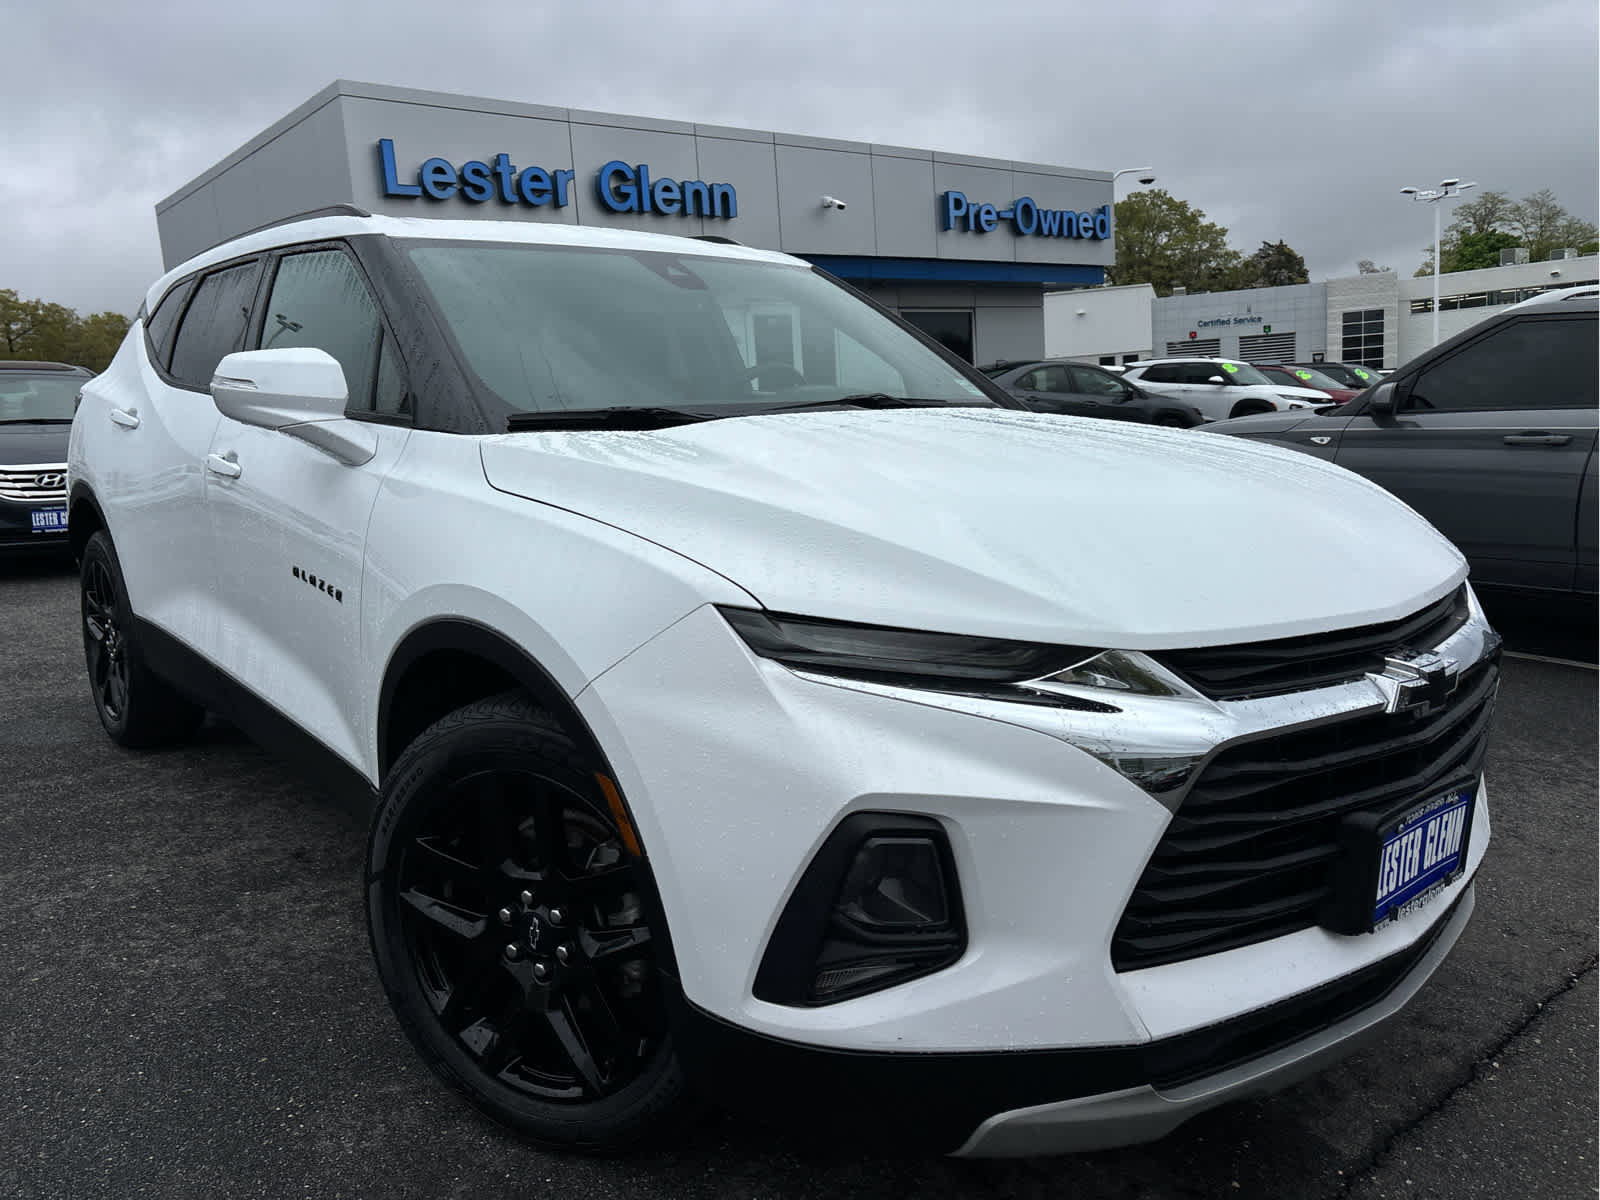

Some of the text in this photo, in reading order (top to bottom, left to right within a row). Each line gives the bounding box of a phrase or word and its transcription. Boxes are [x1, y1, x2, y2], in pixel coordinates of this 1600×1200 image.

[377, 138, 738, 218] Lester Glenn
[943, 190, 1111, 240] Pre-Owned
[1197, 316, 1263, 328] Certified Service
[31, 511, 59, 526] LESTER
[291, 565, 343, 604] BLAZER
[1375, 827, 1423, 902] LESTER
[1424, 805, 1467, 870] GLENN
